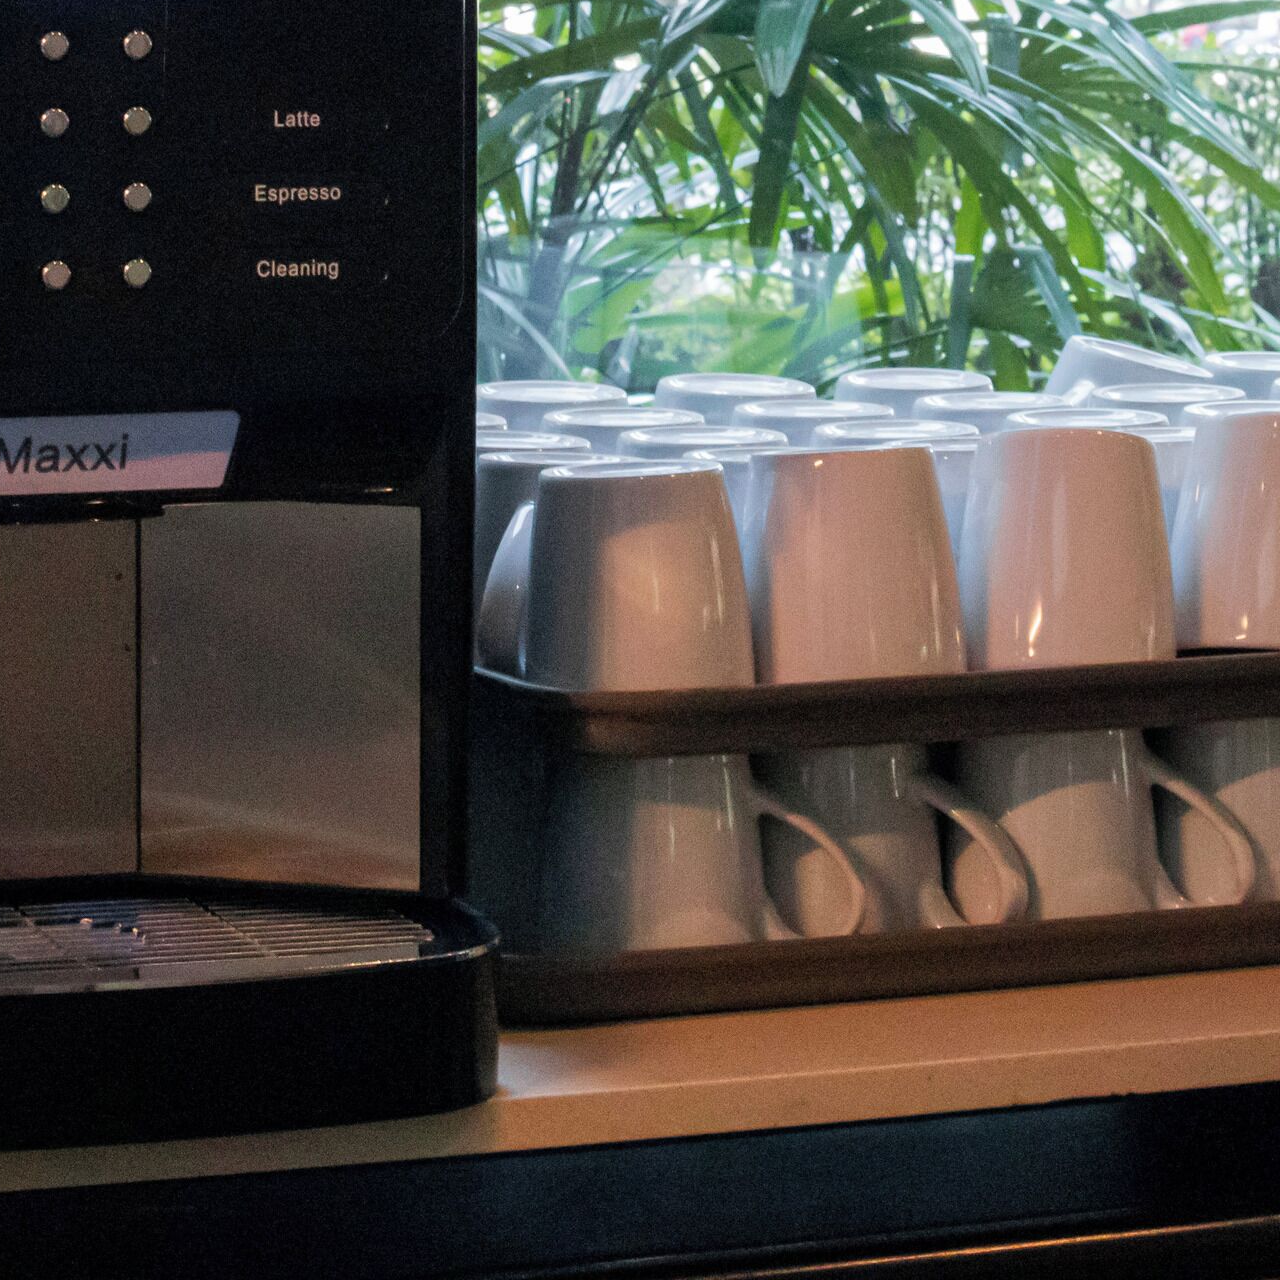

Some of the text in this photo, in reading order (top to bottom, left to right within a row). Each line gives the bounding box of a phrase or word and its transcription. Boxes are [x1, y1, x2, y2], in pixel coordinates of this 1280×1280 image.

[273, 110, 320, 128] Latte
[254, 183, 342, 205] Espresso
[256, 259, 340, 280] Cleaning
